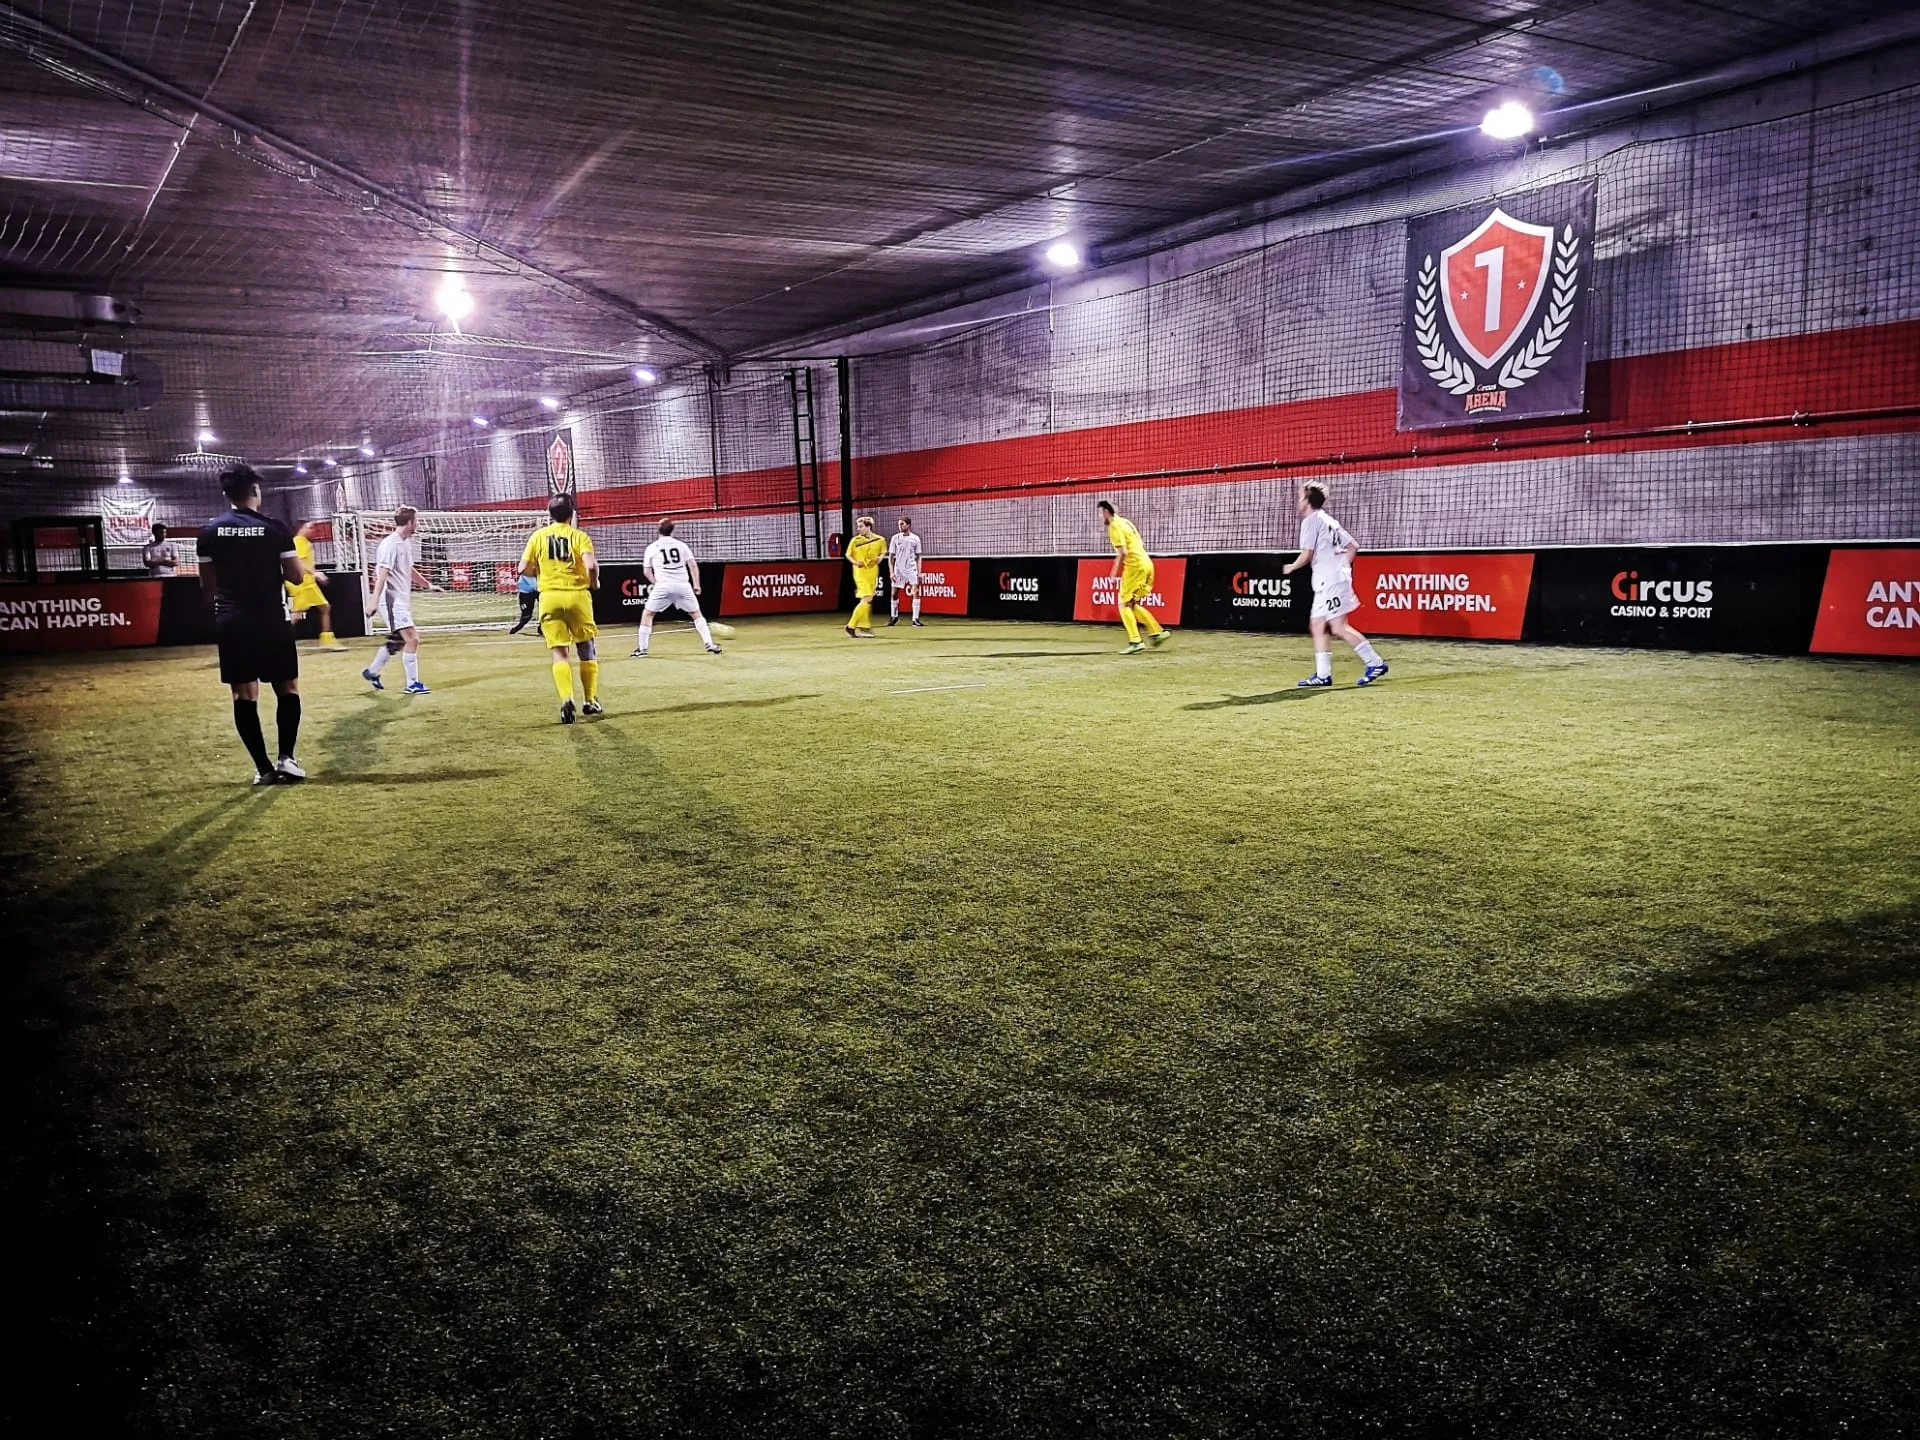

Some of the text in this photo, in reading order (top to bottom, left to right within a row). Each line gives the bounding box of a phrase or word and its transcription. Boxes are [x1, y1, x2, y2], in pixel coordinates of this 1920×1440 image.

[1475, 246, 1505, 333] 1
[1465, 390, 1507, 412] ARENA
[217, 526, 265, 537] REFEREE
[660, 547, 681, 565] 19
[742, 573, 806, 586] ANYTHING
[1000, 571, 1039, 592] Circus
[1232, 571, 1292, 596] Circus
[1375, 573, 1470, 592] ANYTHING
[1611, 571, 1713, 603] Circus
[742, 585, 823, 598] CAN HAPPEN.
[923, 585, 957, 598] HAPPEN.
[1000, 593, 1039, 601] CASINO & SPORT
[1092, 592, 1115, 605] CAN
[0, 598, 101, 614] ANYTHING
[1232, 598, 1292, 608] CASINO & SPORT
[1326, 596, 1341, 611] 20
[1375, 592, 1497, 612] CAN HAPPEN.
[1610, 605, 1712, 619] CASINO & SPORT
[0, 612, 131, 631] CAN HAPPEN.
